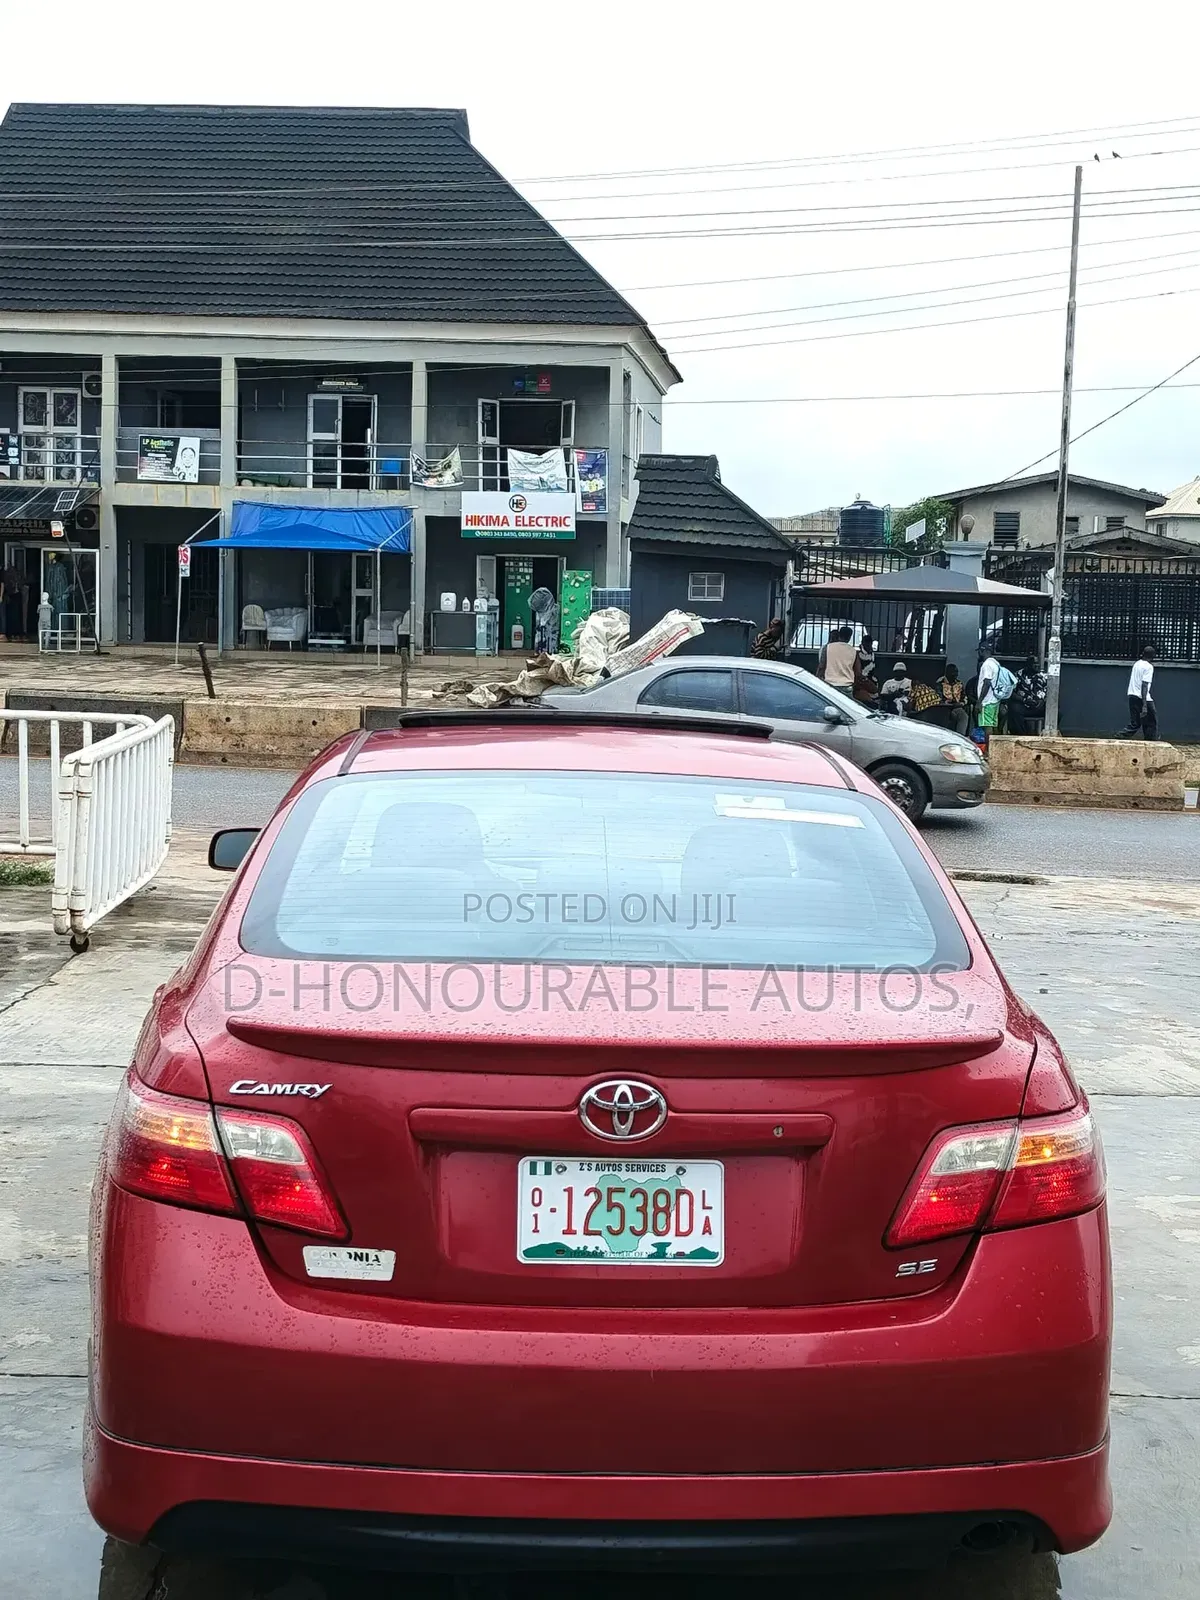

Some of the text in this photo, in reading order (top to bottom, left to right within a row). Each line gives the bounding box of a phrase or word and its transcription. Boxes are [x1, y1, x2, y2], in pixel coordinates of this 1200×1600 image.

[465, 514, 571, 528] HIKIMA ELECTRIC
[229, 1079, 333, 1099] CAMRY
[595, 1163, 622, 1172] AUTOS
[625, 1163, 666, 1173] SERVICES
[895, 1258, 938, 1278] SE
